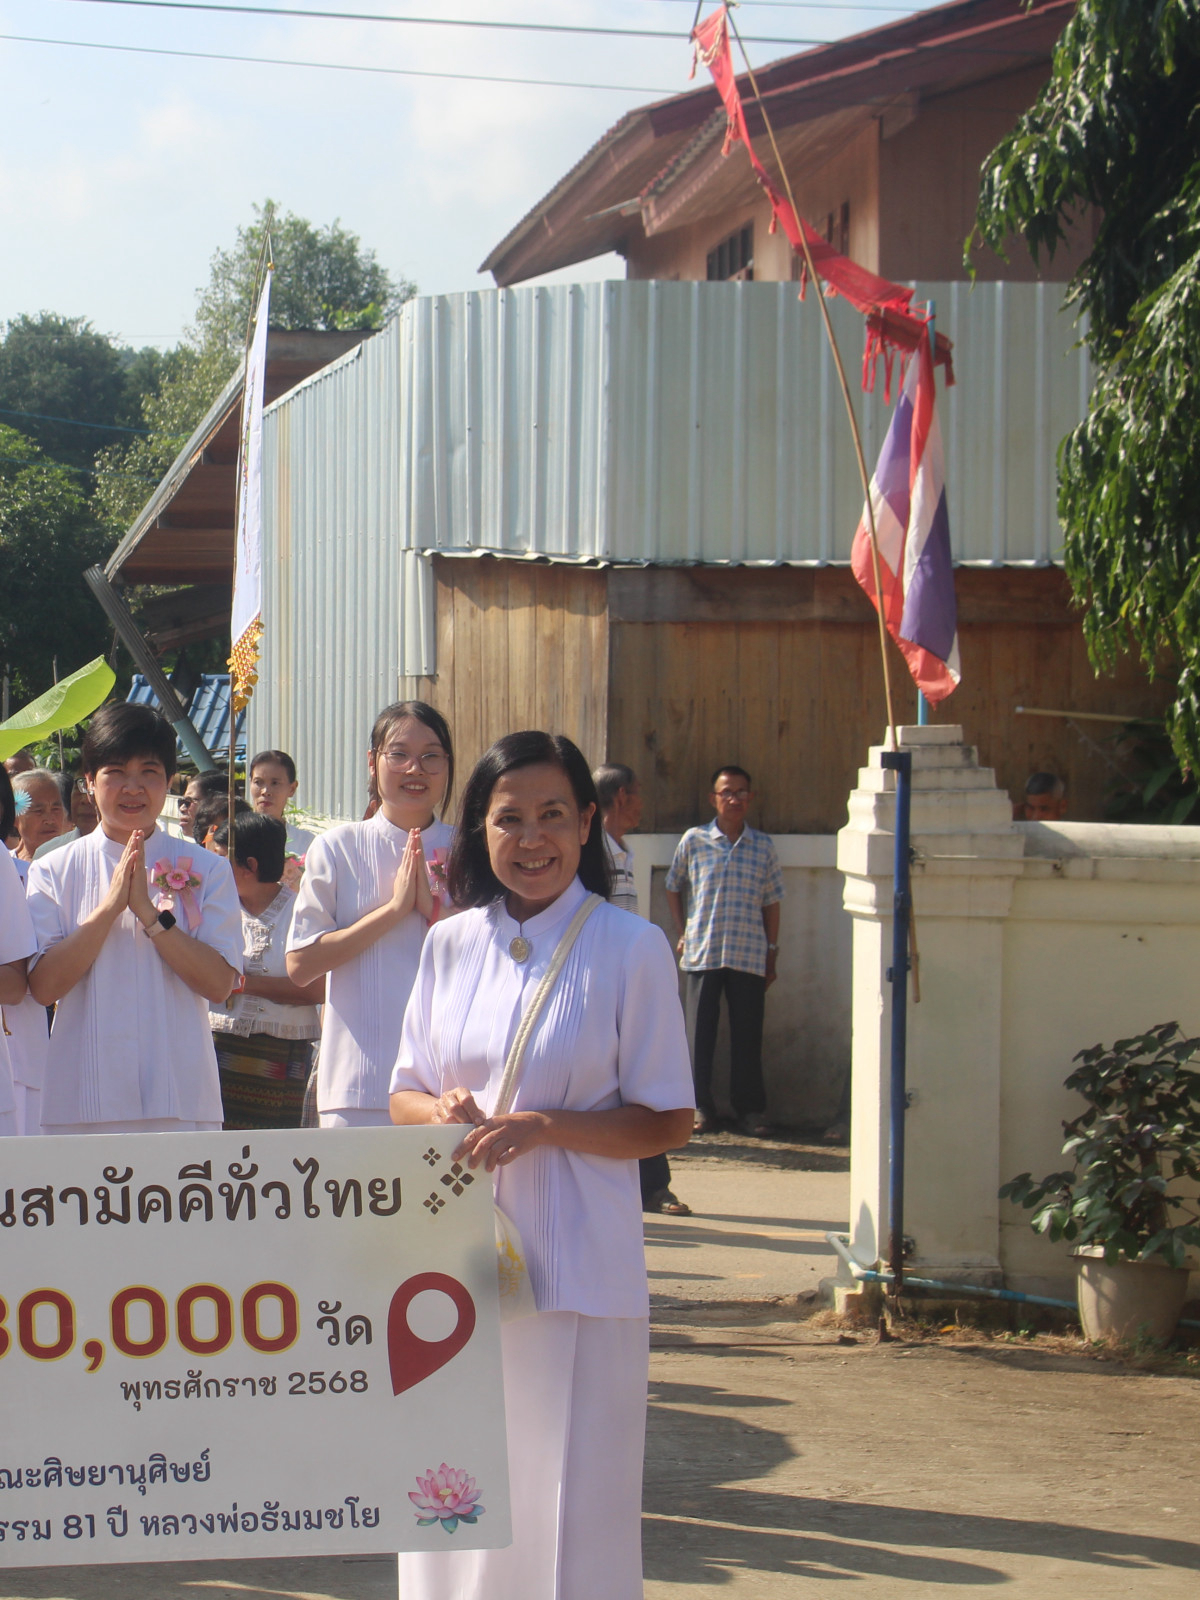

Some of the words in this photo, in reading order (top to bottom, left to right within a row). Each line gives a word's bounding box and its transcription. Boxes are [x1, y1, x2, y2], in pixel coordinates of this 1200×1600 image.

[316, 1300, 373, 1346] วัด
[120, 1369, 277, 1412] พุทธศักราช
[288, 1369, 369, 1395] 2568
[63, 1513, 96, 1540] 81
[106, 1504, 129, 1538] ปี
[139, 1496, 380, 1537] หลวงพ่อธัมมชโย
